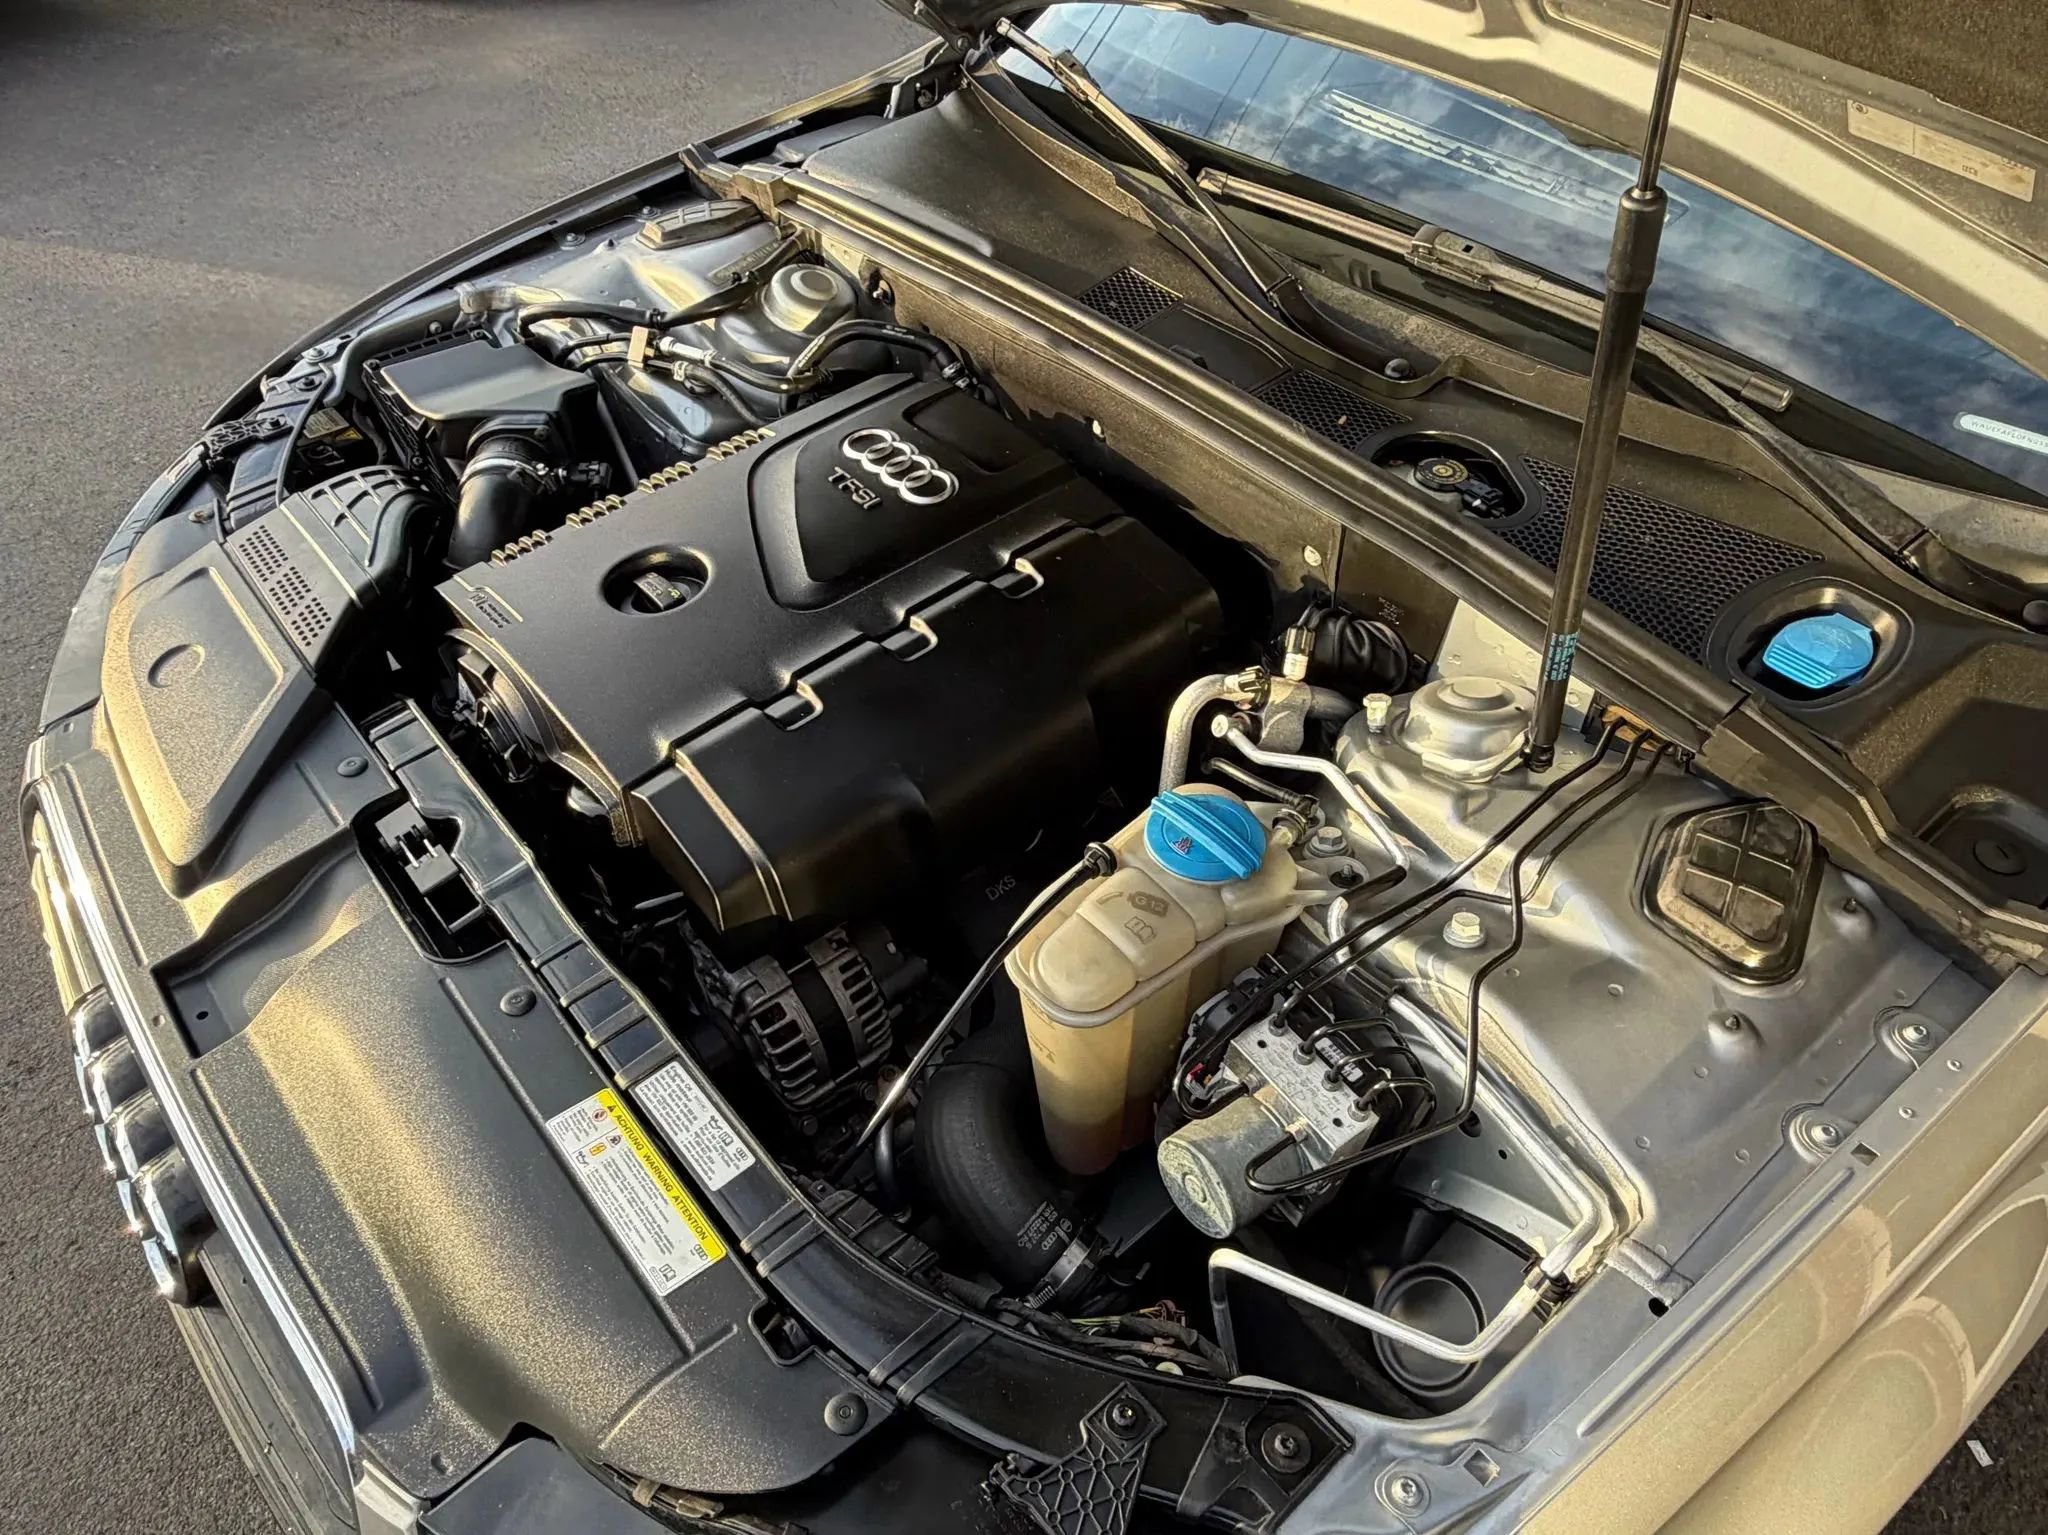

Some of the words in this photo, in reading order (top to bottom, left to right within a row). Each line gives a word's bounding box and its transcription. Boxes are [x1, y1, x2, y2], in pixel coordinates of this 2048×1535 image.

[828, 466, 881, 510] TFSI
[985, 874, 1017, 901] DKS
[614, 1112, 644, 1151] ACHTUNG
[642, 1151, 674, 1192] WARNING
[671, 1193, 708, 1241] ATTENTION
